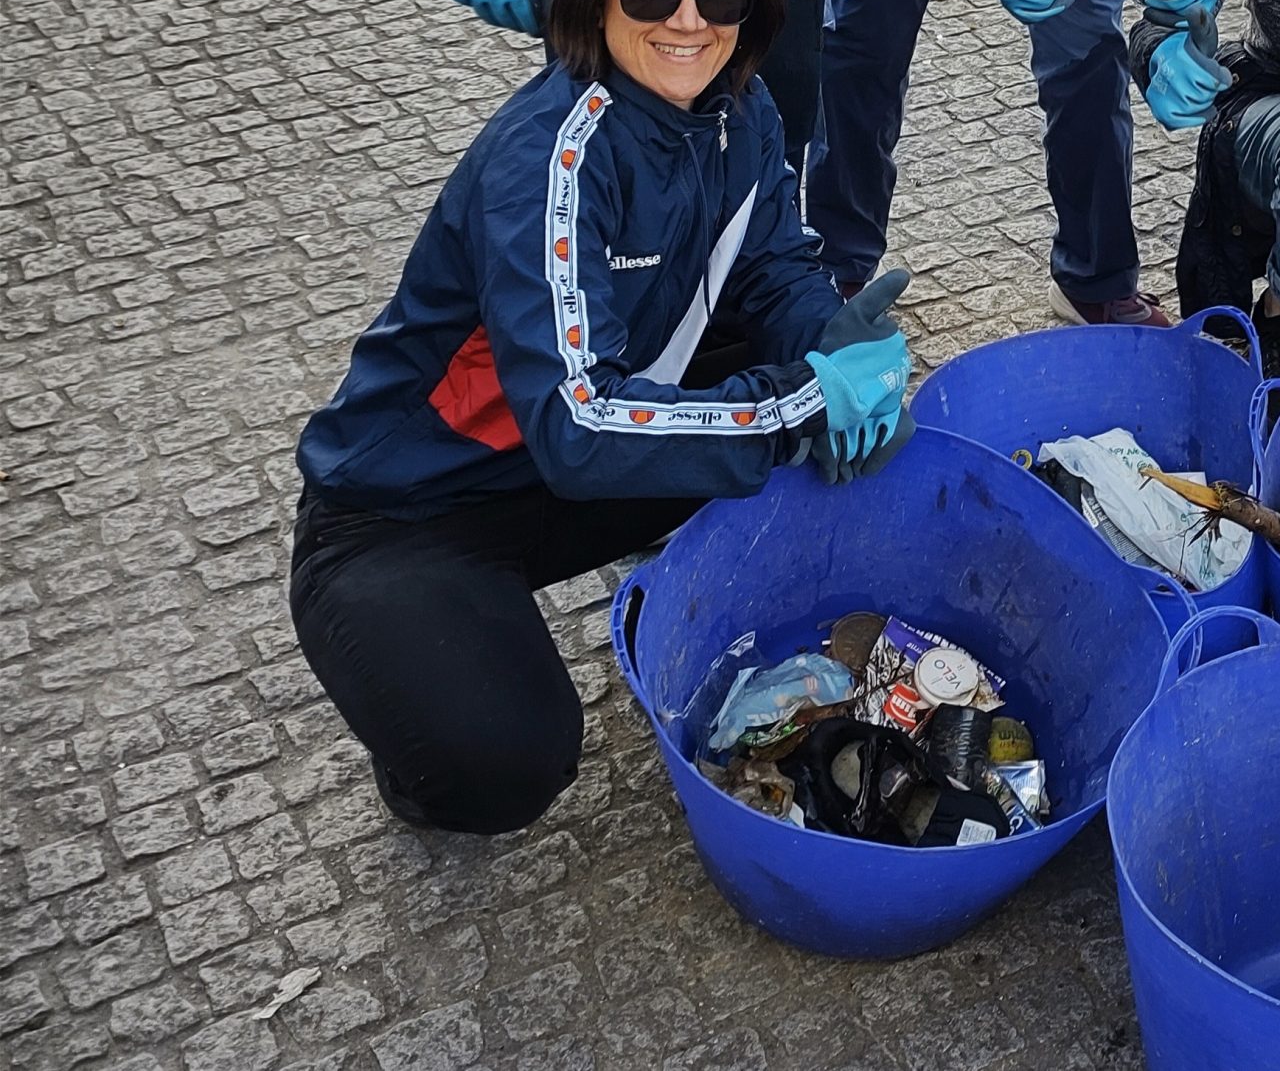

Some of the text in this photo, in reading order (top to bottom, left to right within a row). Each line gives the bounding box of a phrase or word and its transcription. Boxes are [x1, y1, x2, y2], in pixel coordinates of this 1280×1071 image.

[555, 176, 571, 225] ellesse
[667, 409, 722, 425] ellesse
[934, 659, 961, 690] VELO
